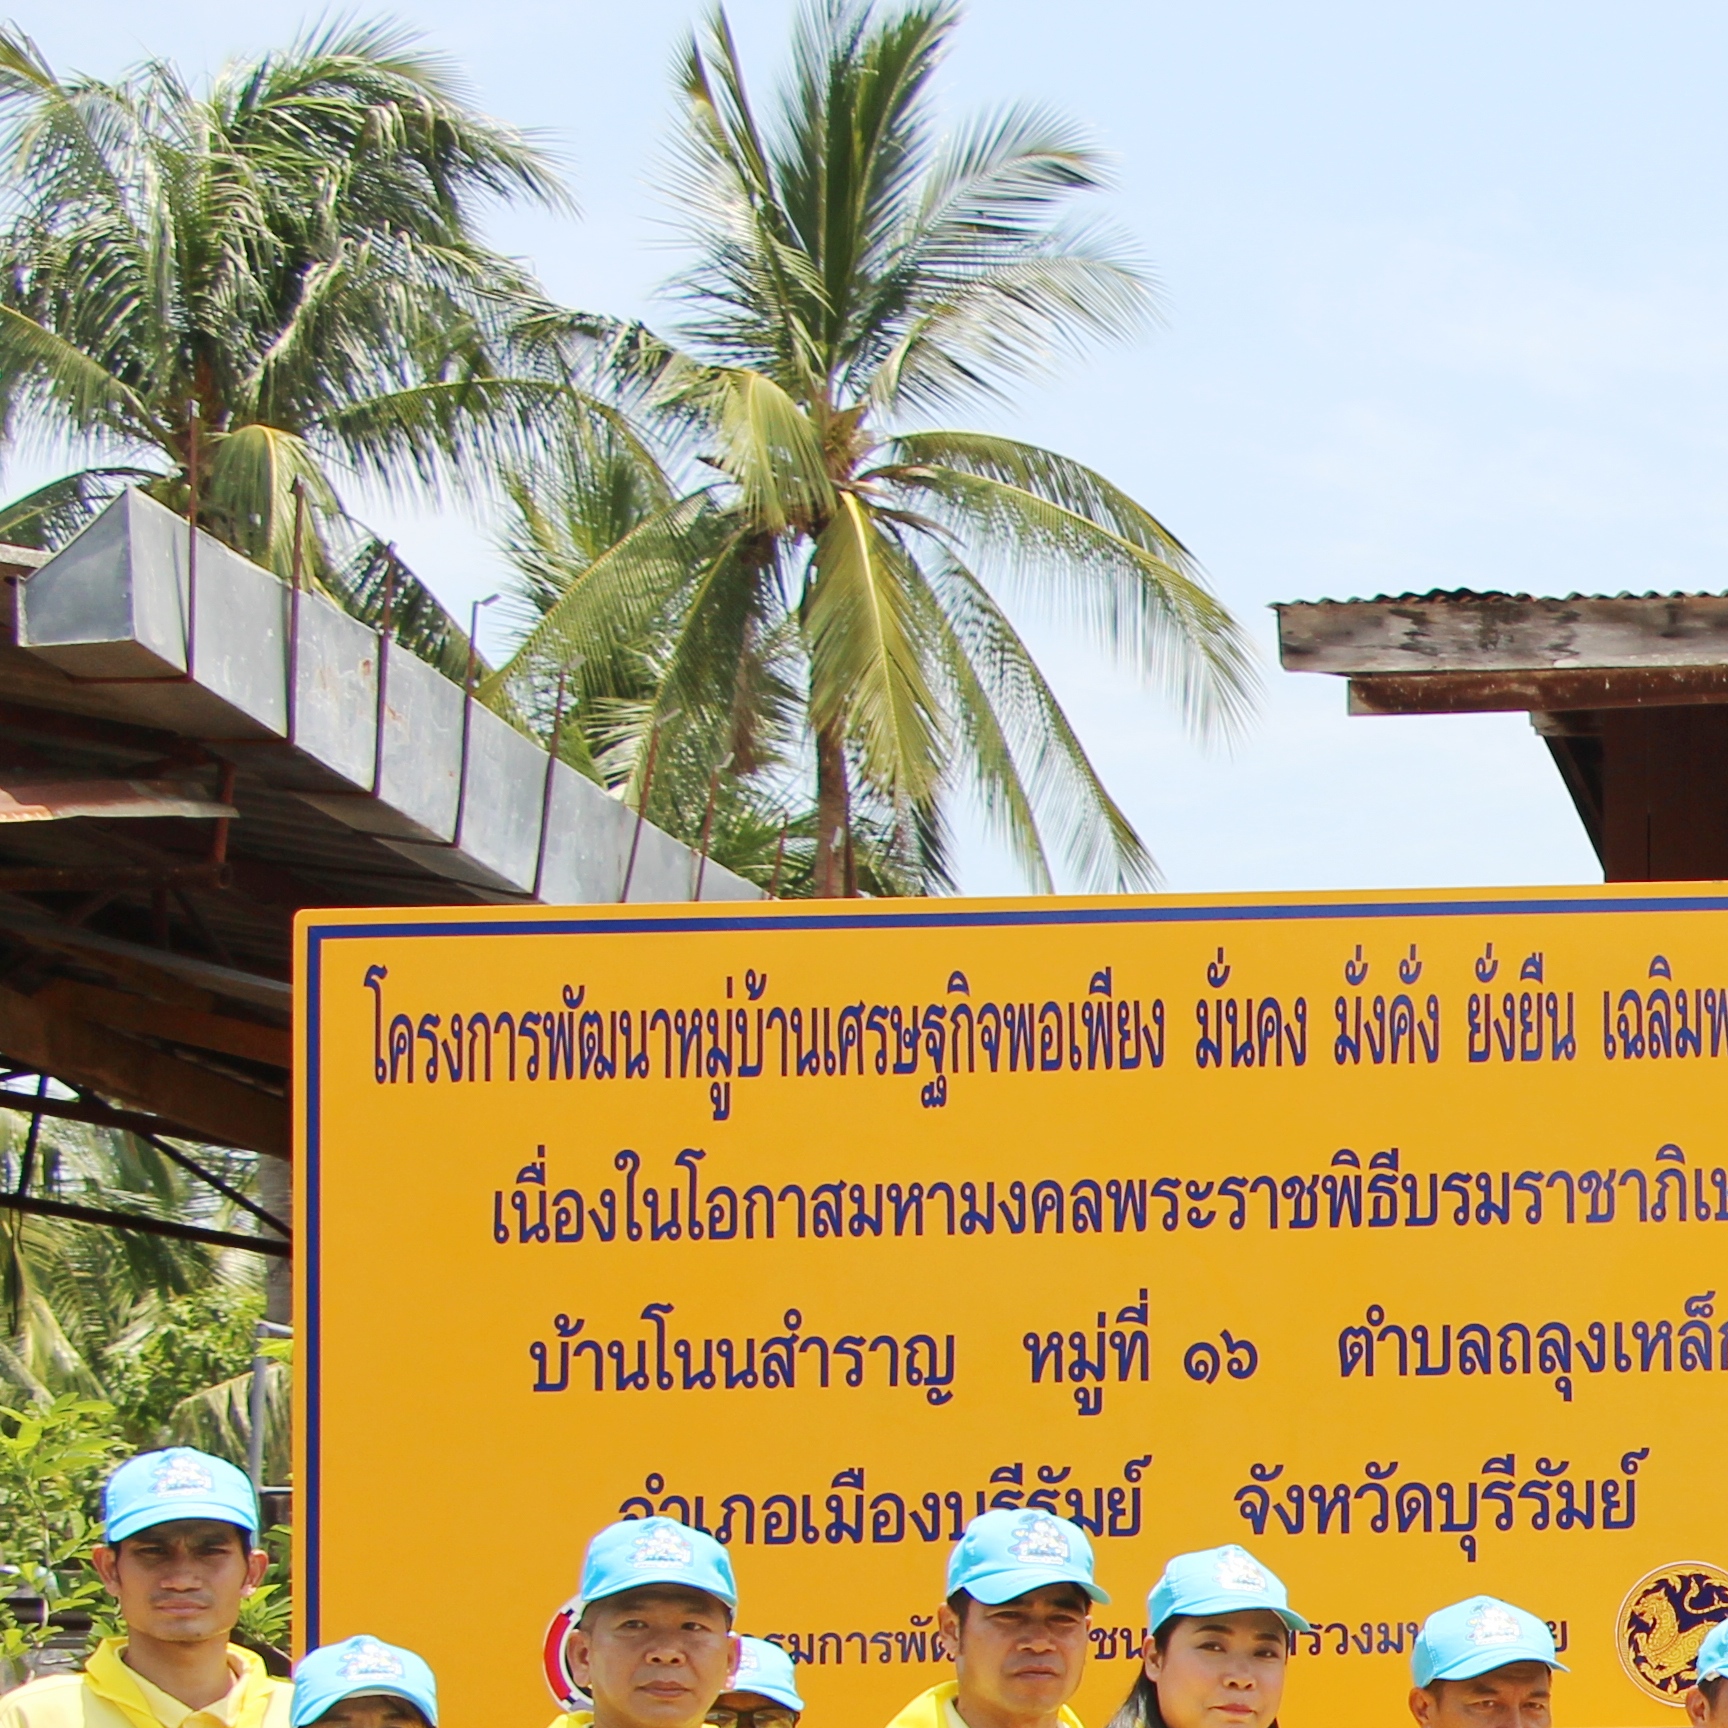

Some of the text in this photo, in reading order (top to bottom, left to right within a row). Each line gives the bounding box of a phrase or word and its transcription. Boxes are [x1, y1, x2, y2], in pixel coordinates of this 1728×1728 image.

[363, 964, 1166, 1120] โครงการพัฒนาหมู่บ้านเศรษฐกิจพอเพียง
[1195, 947, 1308, 1068] มั่นคง
[1333, 944, 1440, 1065] มั่งคั่ง
[1467, 943, 1576, 1063] ยั่งยืน
[529, 1303, 955, 1406] บ้านโนนสำราญ
[1023, 1289, 1150, 1416] หมู่ที่
[1183, 1330, 1259, 1384] ๑๖
[619, 1447, 1649, 1562] ำเภอเมืองบีัมย์ จังหวัดบุรีรัมย์
